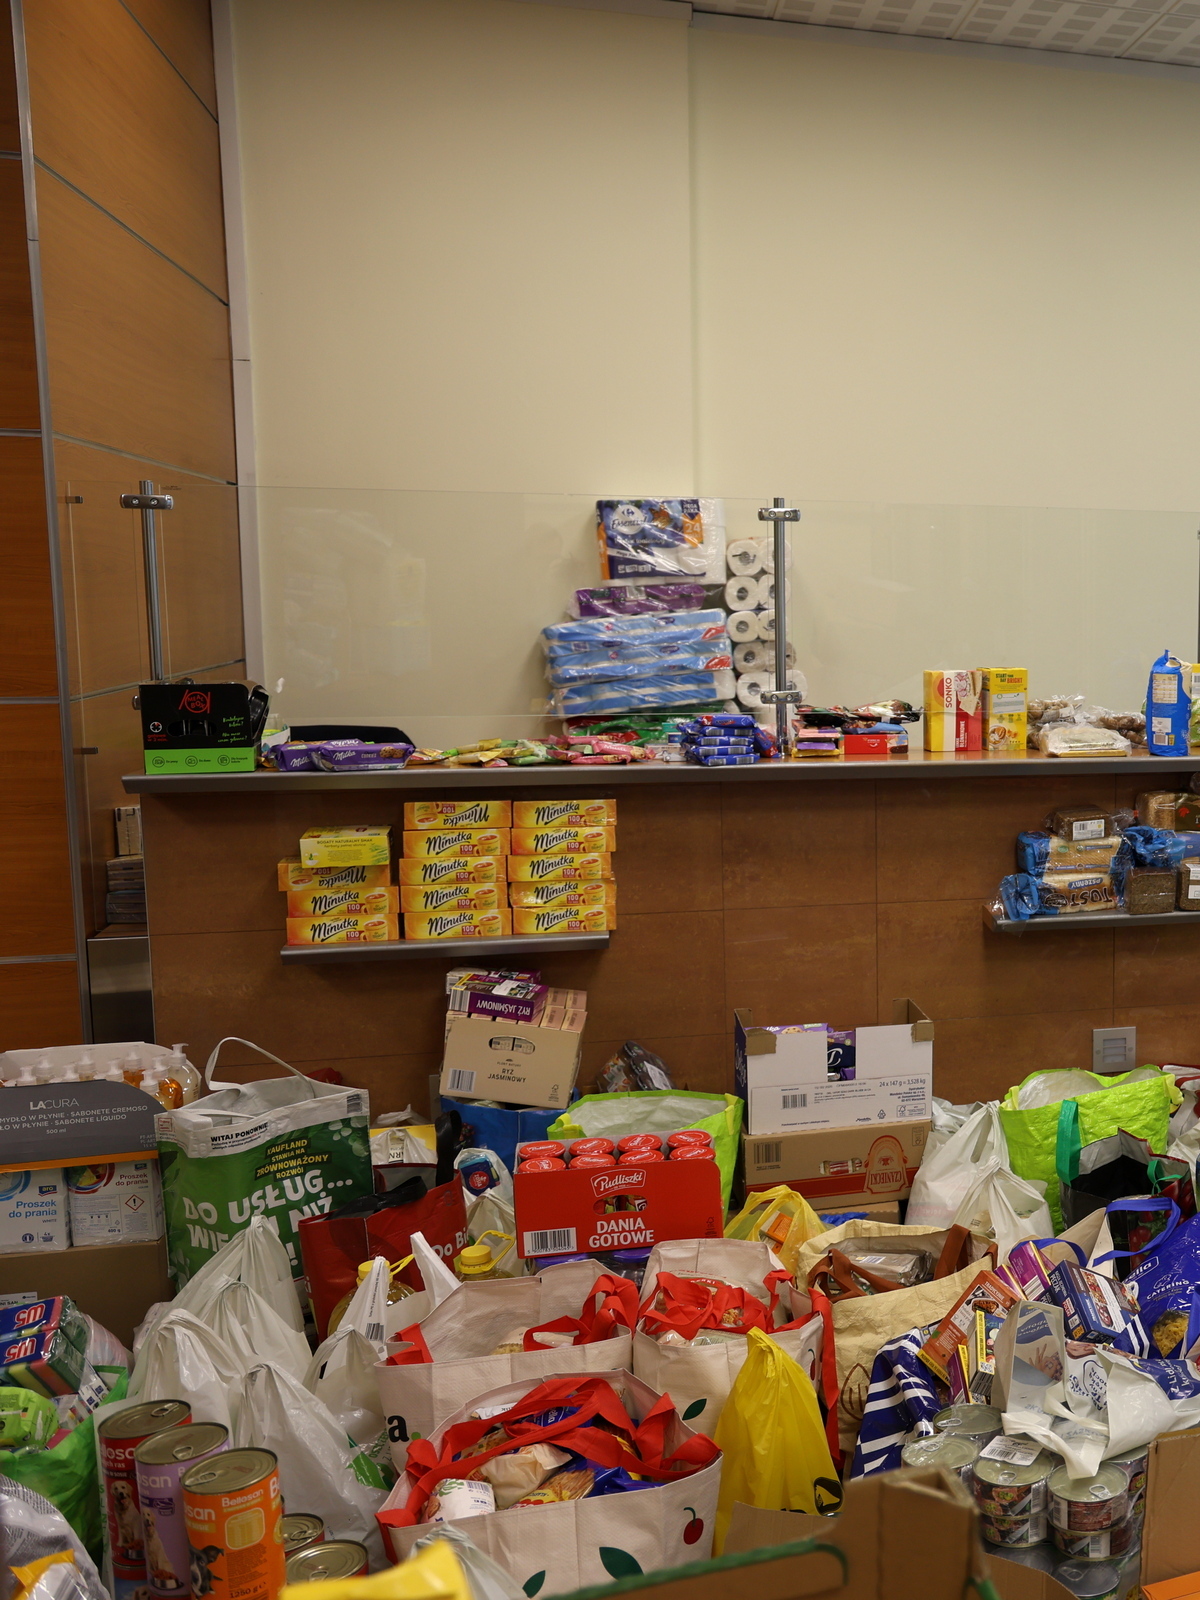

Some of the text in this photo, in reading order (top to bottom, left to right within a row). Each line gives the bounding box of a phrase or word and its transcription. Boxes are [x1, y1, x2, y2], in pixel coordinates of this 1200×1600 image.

[945, 677, 953, 708] SONKO
[443, 803, 490, 825] Minutka
[535, 802, 580, 825] Minutka
[568, 815, 580, 823] 100
[426, 831, 473, 856] Minutka
[535, 828, 580, 851] Minutka
[422, 859, 468, 883] Minutka
[530, 854, 575, 879] Minutka
[563, 868, 575, 876] 100
[311, 890, 360, 914] Minutka
[424, 886, 470, 910] Minutka
[534, 880, 579, 904] Minutka
[567, 894, 579, 902] 100
[1069, 887, 1113, 907] TOST
[428, 912, 474, 936] Minutka
[535, 907, 580, 931] Minutka
[311, 917, 359, 944] Minutka
[347, 931, 359, 939] 100
[475, 999, 531, 1015] RYŻ JAŚMINOWY
[487, 1074, 526, 1083] JAŚMINOWY
[502, 1068, 514, 1076] RYŻ
[29, 1098, 80, 1111] LACURA
[70, 1108, 110, 1117] SABONETE
[111, 1105, 148, 1113] CREMOSO
[22, 1120, 49, 1129] PŁYNIE
[54, 1117, 94, 1126] SABONETE
[210, 1132, 234, 1142] WITAJ
[235, 1122, 268, 1139] PONOWNIE
[266, 1139, 308, 1156] KAUFLAND
[271, 1150, 295, 1163] STAWIA
[256, 1154, 329, 1178] ZRÓWNOWAŻONY
[126, 1179, 149, 1187] prania
[594, 1170, 643, 1192] Pudliszki
[8, 1209, 57, 1219] do prania
[16, 1200, 57, 1208] Proszek
[182, 1197, 218, 1225] DO
[596, 1217, 645, 1234] DANIA
[588, 1229, 655, 1249] GOTOWE
[1125, 1261, 1152, 1282] ella
[1146, 1279, 1190, 1300] CATERING
[221, 1488, 264, 1508] Bellosan
